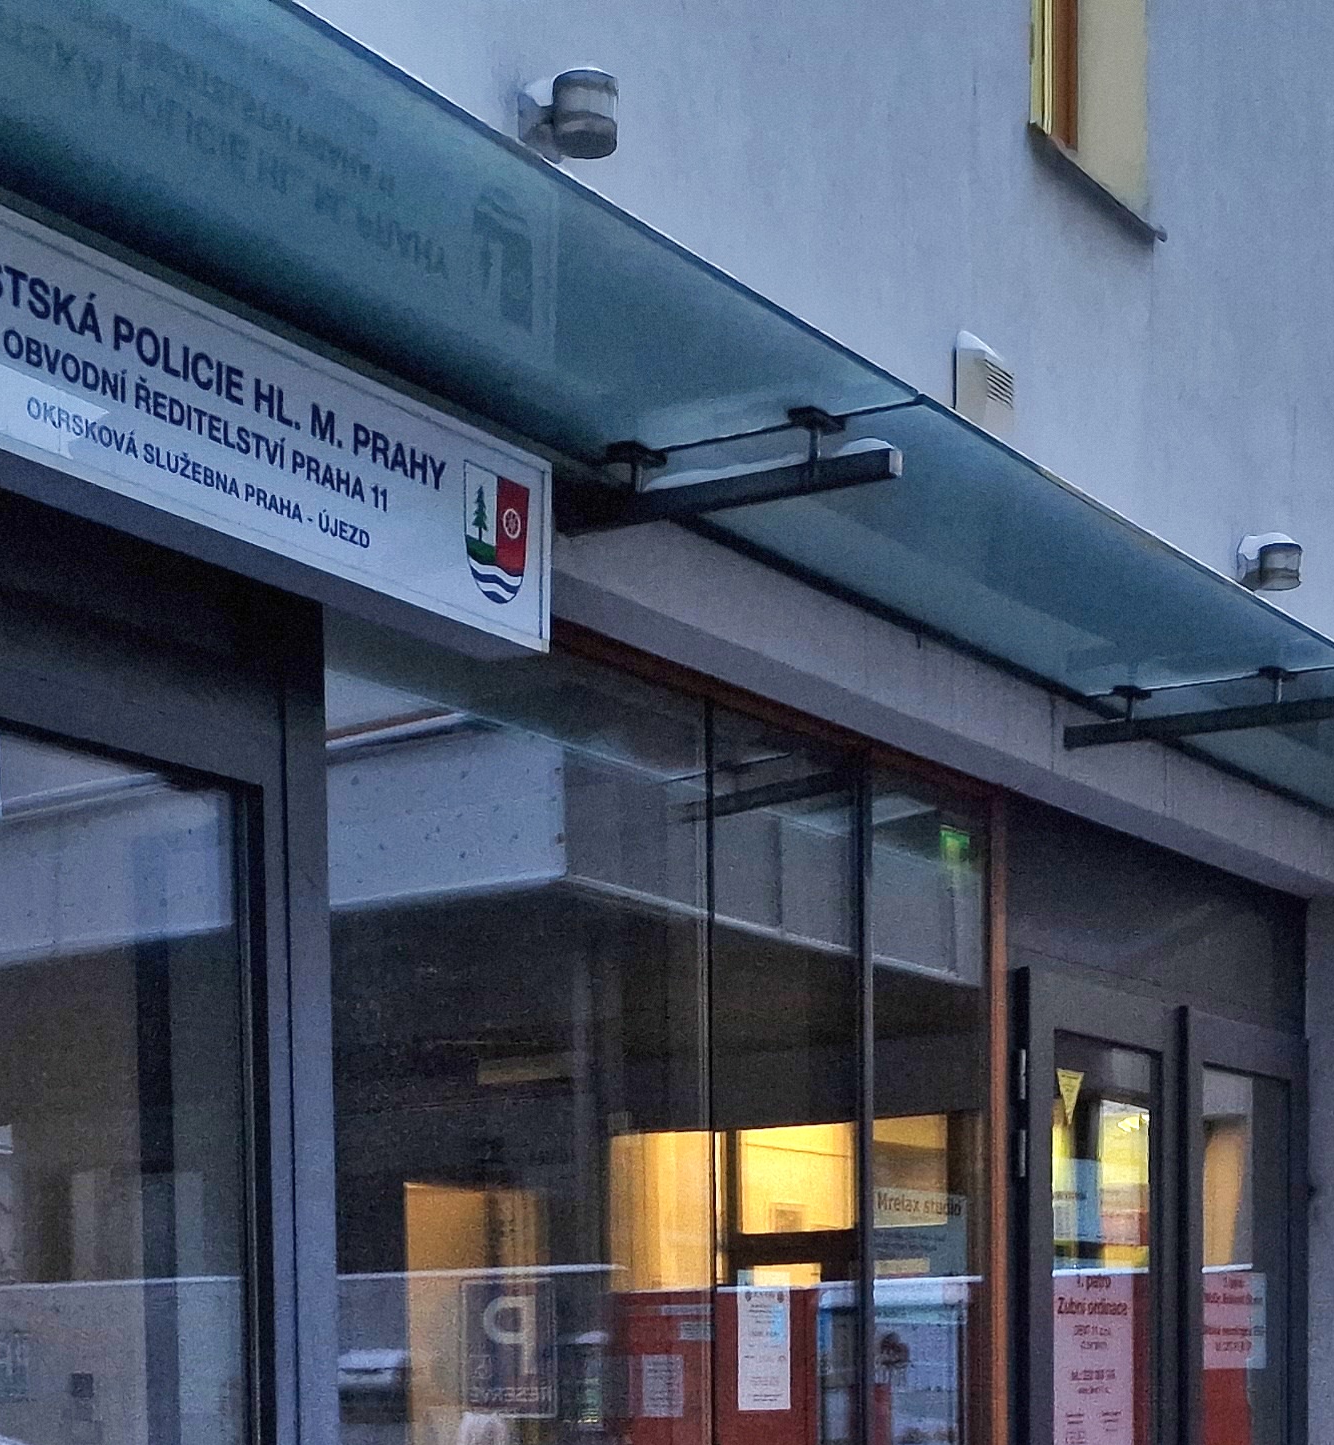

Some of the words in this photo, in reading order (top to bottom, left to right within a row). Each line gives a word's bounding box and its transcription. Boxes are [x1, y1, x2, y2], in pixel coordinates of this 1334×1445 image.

[3, 329, 128, 404] OBVODNÍ
[134, 376, 286, 471] ŘEDITELSTVÍ
[291, 448, 366, 504] PRAHA
[371, 486, 389, 523] 11
[26, 396, 139, 460] OKRSKOVÁ
[143, 442, 240, 499] SLUŽEBNA
[244, 483, 303, 534] PRAHA
[318, 509, 371, 549] ÚJEZD
[113, 313, 244, 406] POLICIE
[254, 378, 301, 431] HL.
[311, 402, 343, 448] M.
[353, 422, 447, 491] PRAHY
[877, 1191, 920, 1213] Mrelax
[924, 1197, 962, 1217] studio
